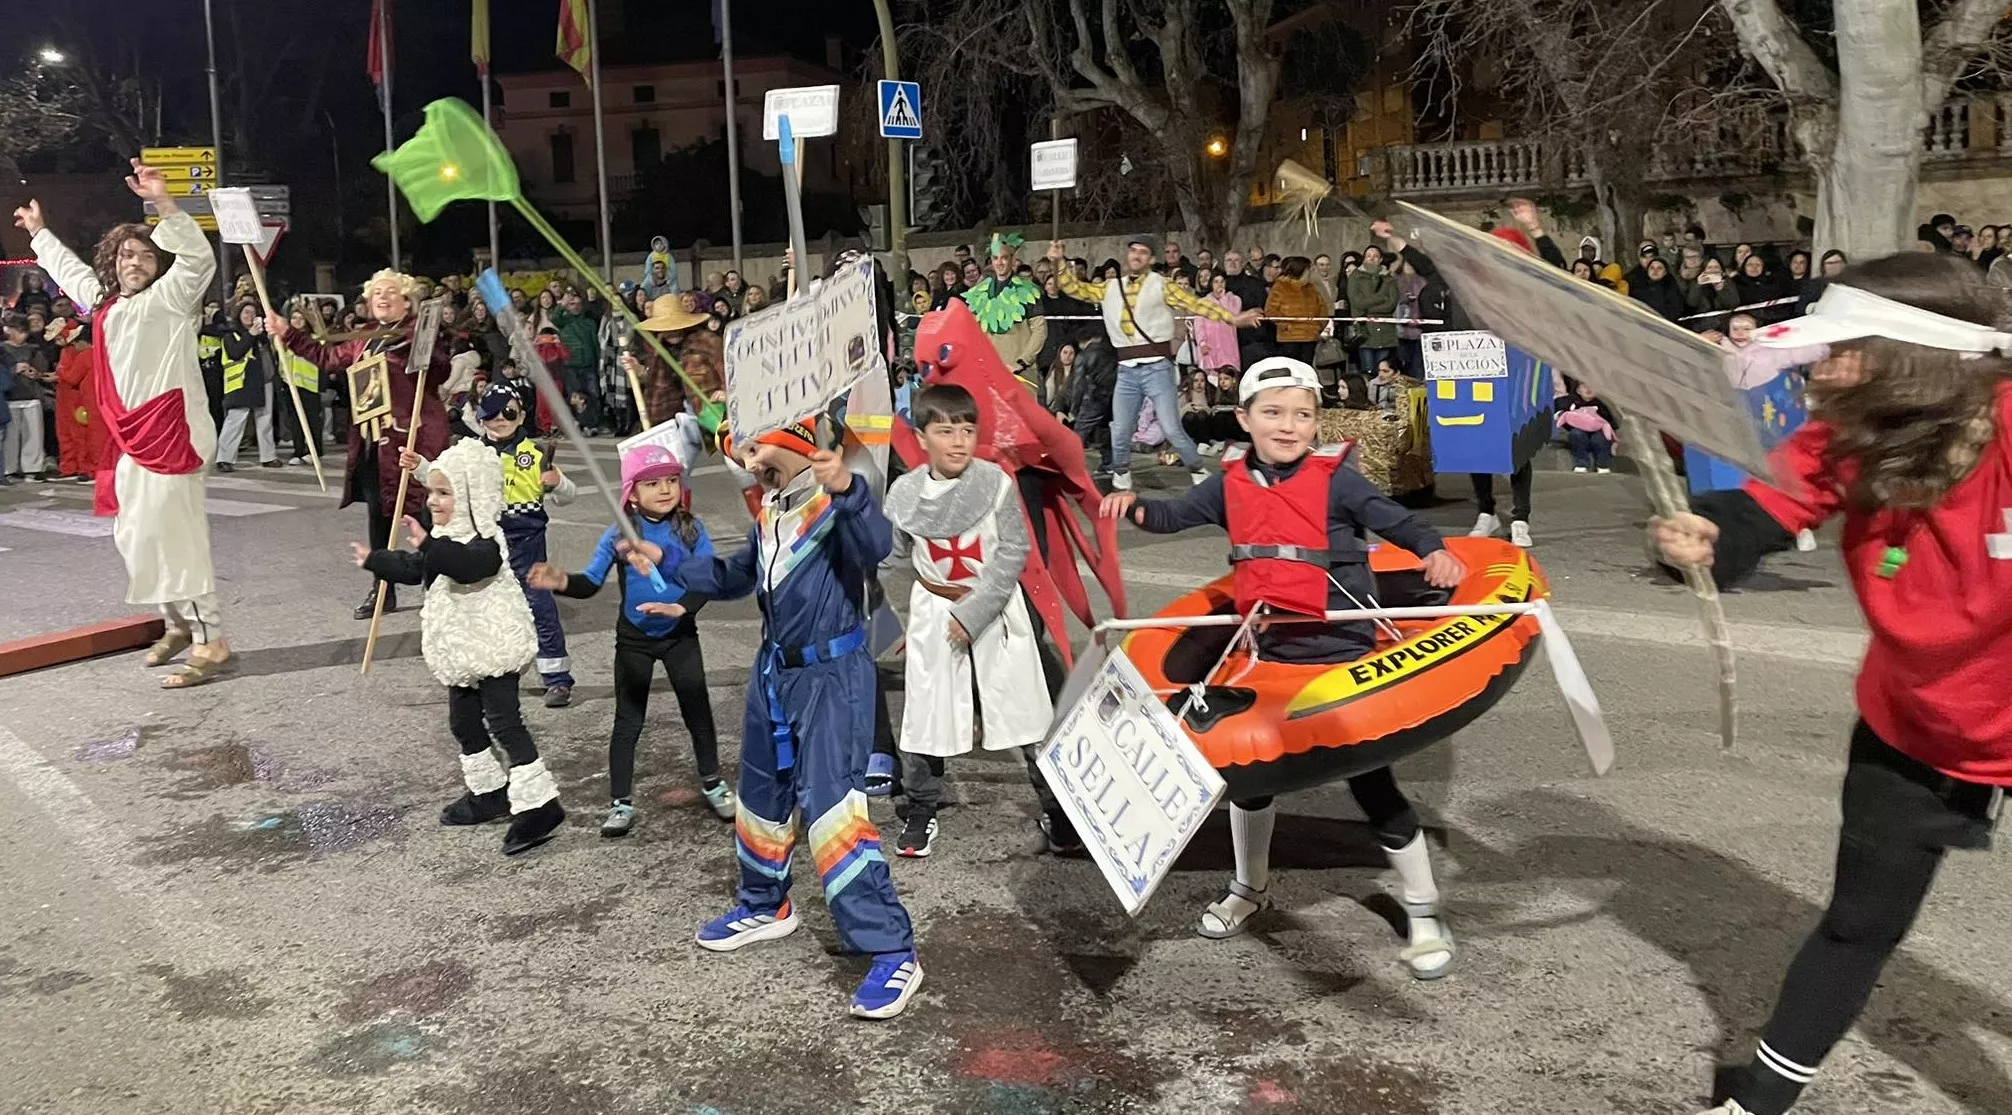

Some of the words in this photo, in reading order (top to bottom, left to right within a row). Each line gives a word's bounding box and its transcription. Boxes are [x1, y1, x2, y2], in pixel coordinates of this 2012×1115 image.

[1430, 356, 1500, 371] ESTACIÓN
[1446, 338, 1497, 351] PLAZA
[1348, 621, 1476, 686] EXPLORER
[1067, 735, 1152, 870] SELLA
[1113, 718, 1189, 822] CALLE
